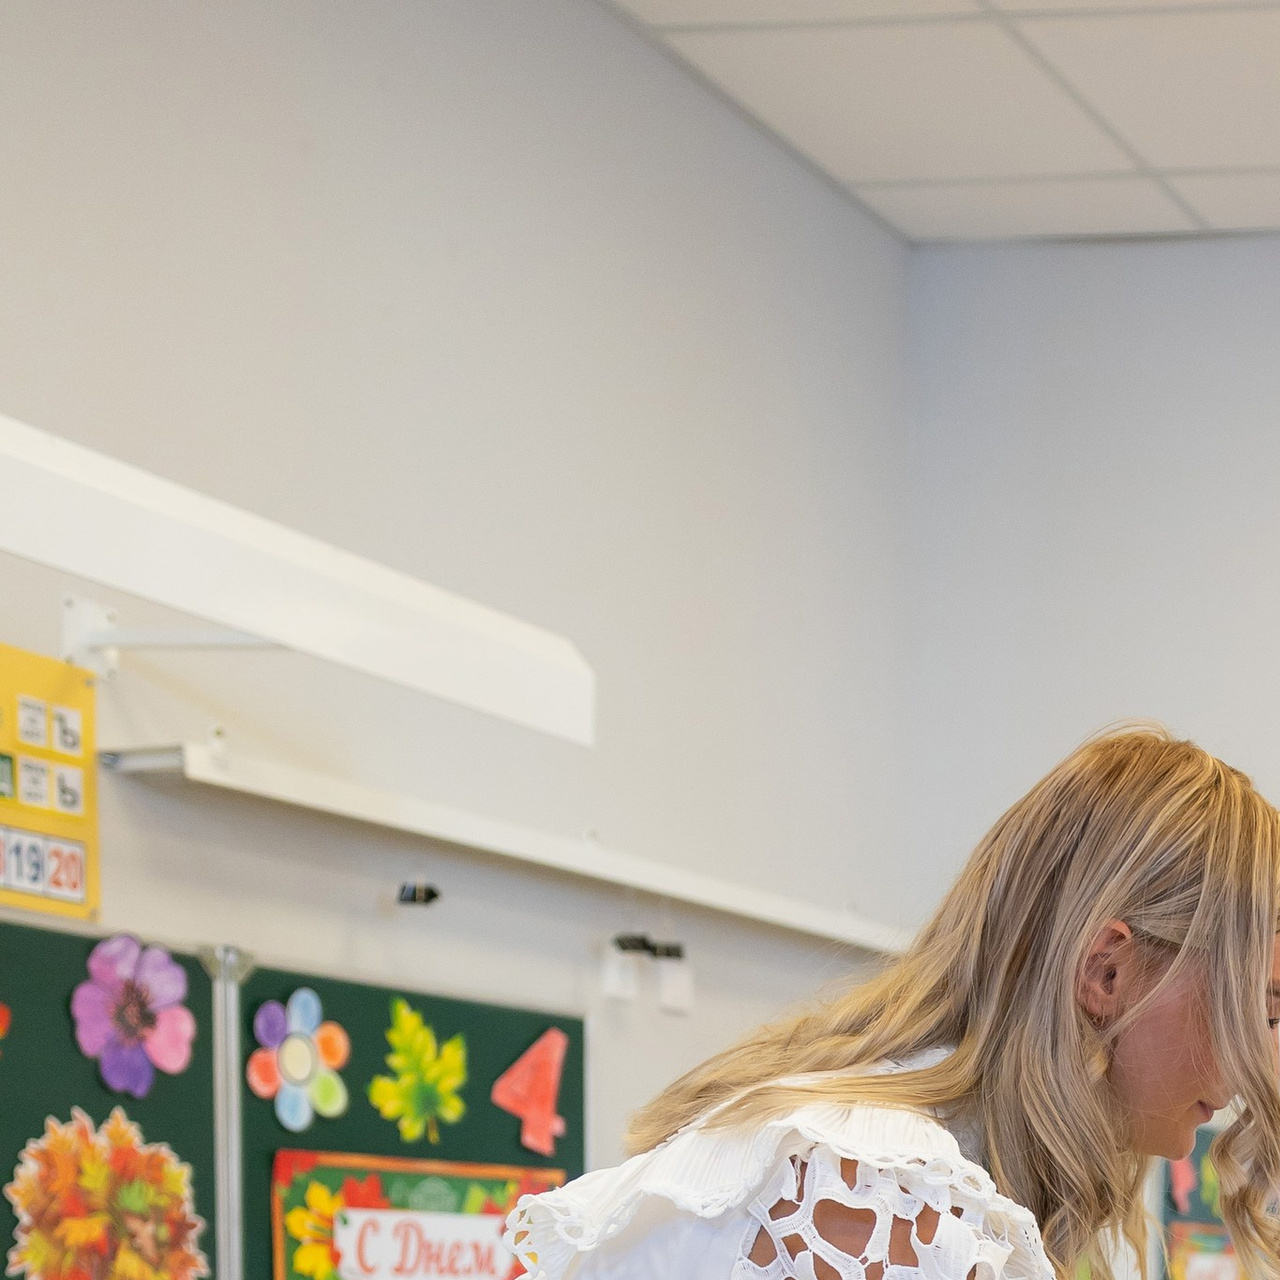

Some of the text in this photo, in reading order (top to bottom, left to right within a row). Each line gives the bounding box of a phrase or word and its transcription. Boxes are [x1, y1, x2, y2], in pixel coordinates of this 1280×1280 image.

[10, 843, 44, 884] 19
[49, 847, 82, 891] 20
[490, 1026, 569, 1157] 4
[356, 1218, 496, 1277] С Днем
